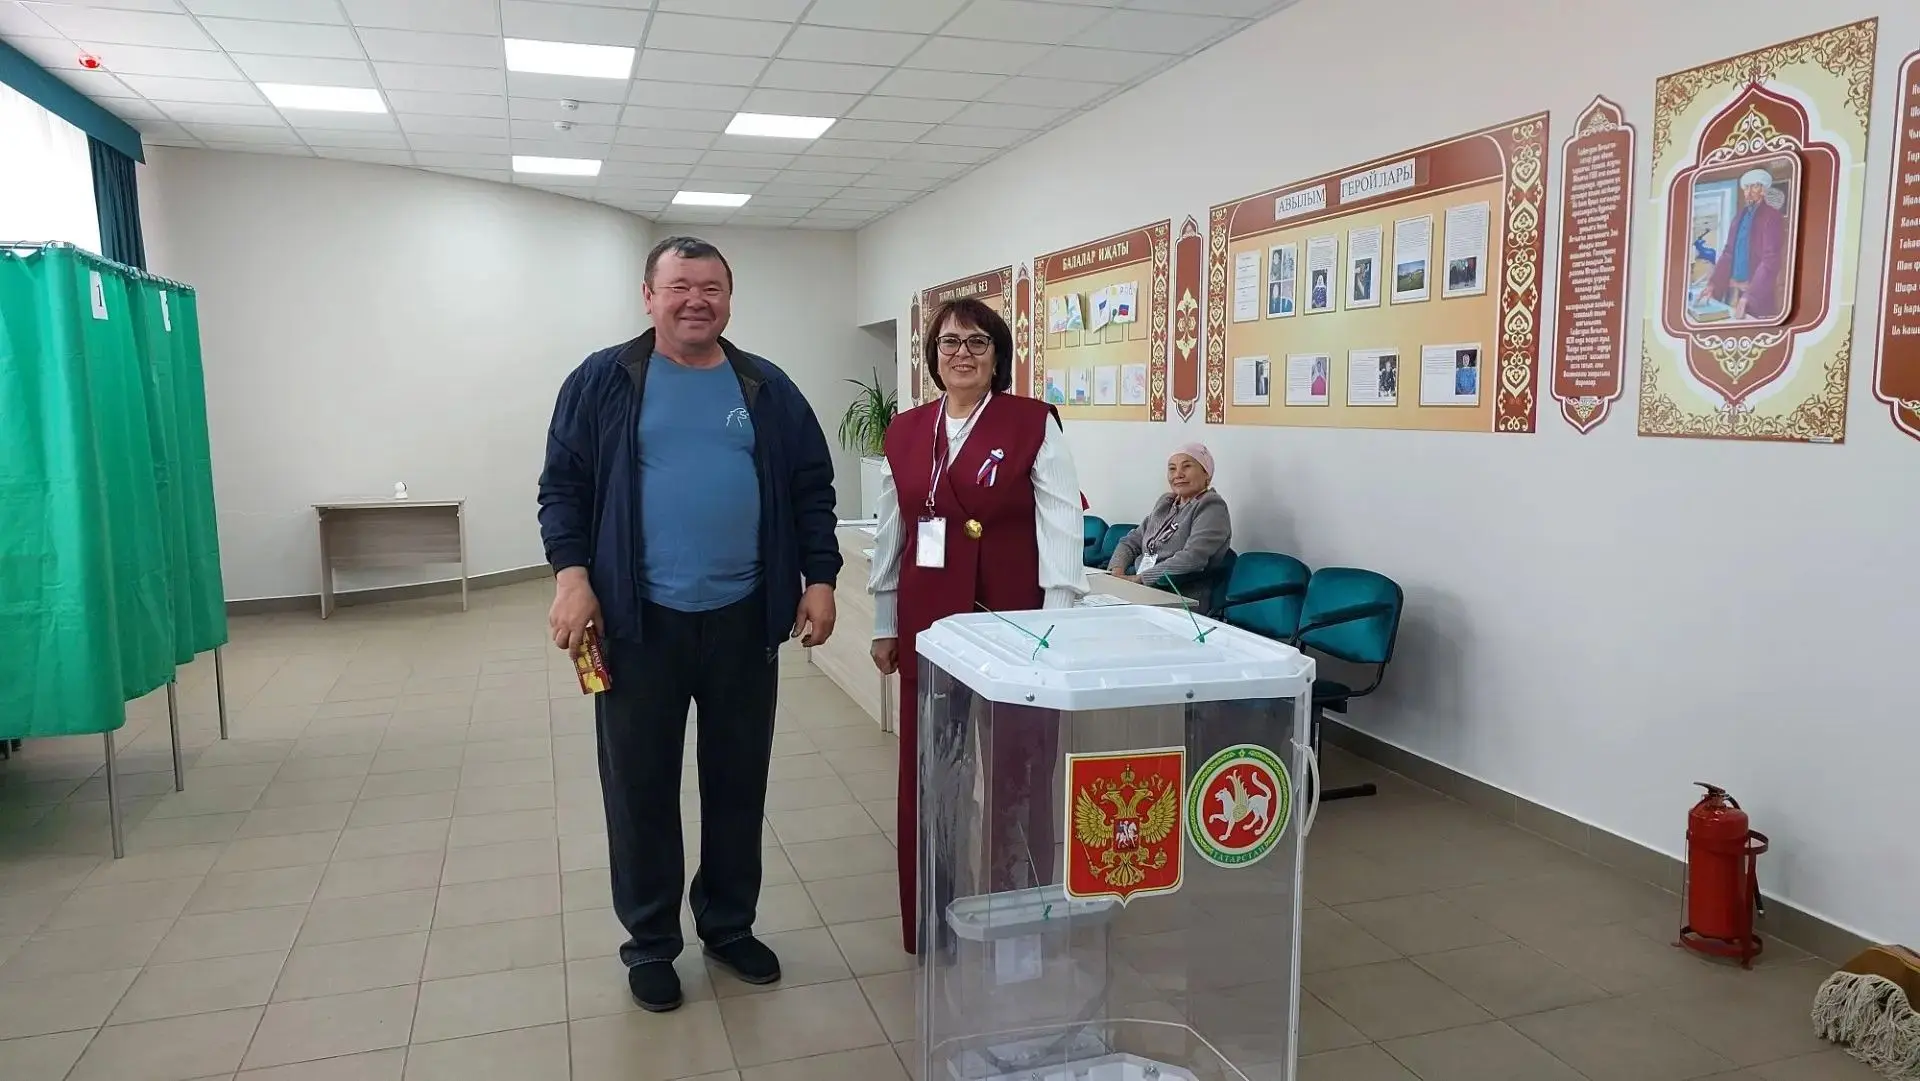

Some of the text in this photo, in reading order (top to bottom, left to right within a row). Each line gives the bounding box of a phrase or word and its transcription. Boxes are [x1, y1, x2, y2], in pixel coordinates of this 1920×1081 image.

[1279, 164, 1413, 213] АВЫЛЫМ ГЕРОЙЛАРЫ
[1062, 241, 1129, 271] БАЛАЛАР ИҖАТЫ
[96, 284, 103, 307] 1
[978, 280, 988, 293] БЕЗ
